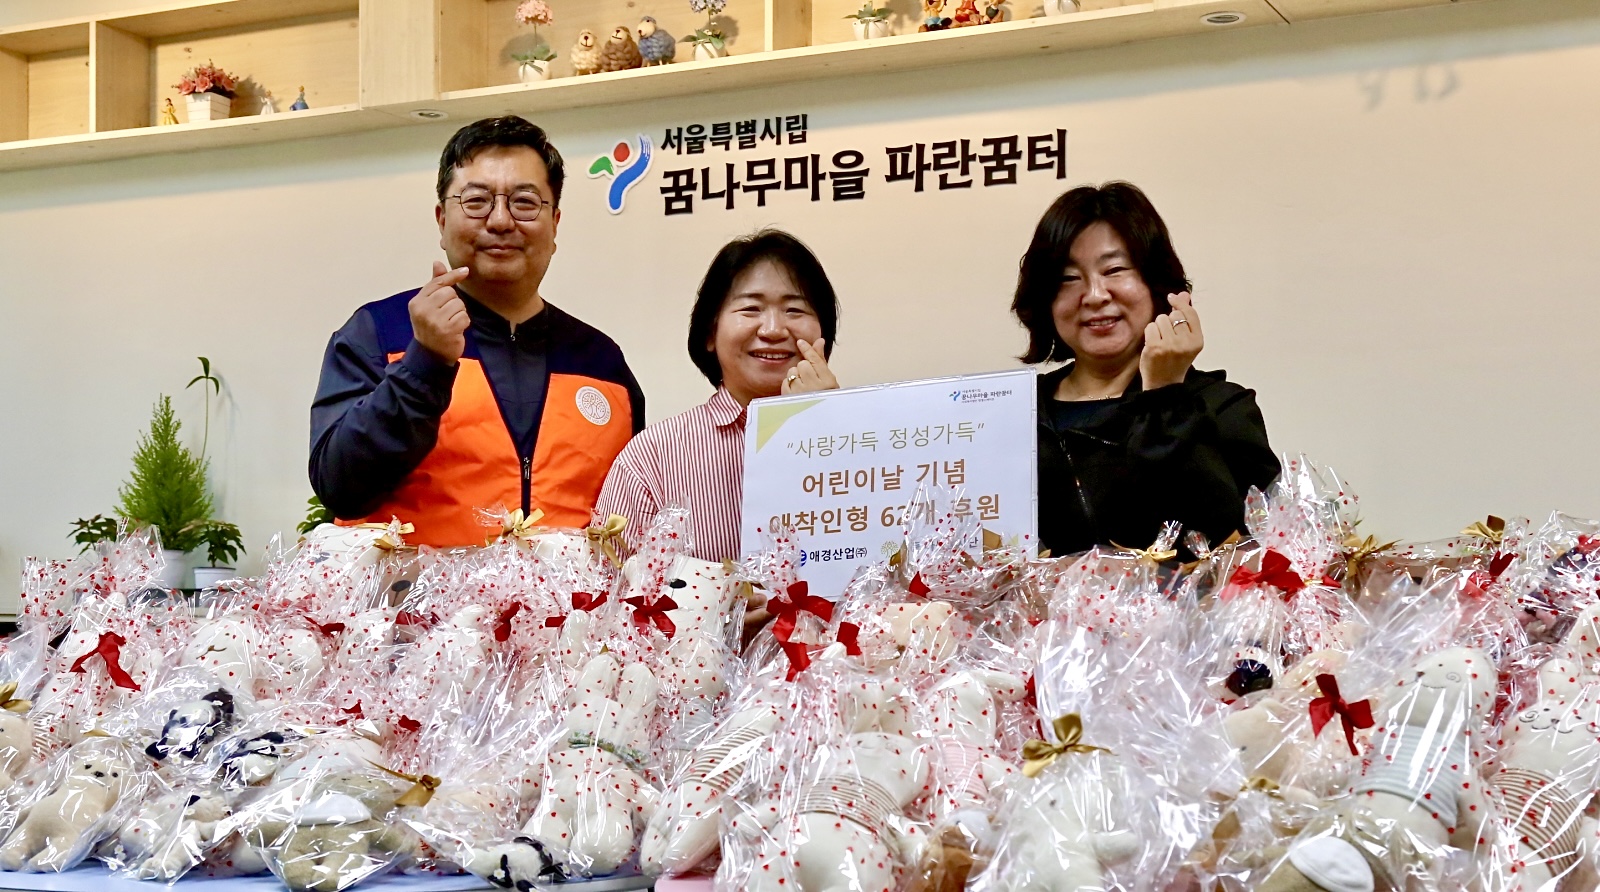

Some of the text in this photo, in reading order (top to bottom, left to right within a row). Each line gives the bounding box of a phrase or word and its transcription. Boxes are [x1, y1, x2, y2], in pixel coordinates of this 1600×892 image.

[660, 113, 808, 156] 서울특별시립
[659, 129, 1068, 216] 꿈나무마을 파란꿈터
[787, 421, 985, 459] “사랑가득 정성가득”
[802, 458, 966, 498] 어린이날 기념
[769, 505, 868, 537] 애착인형
[951, 493, 1000, 523] 후원
